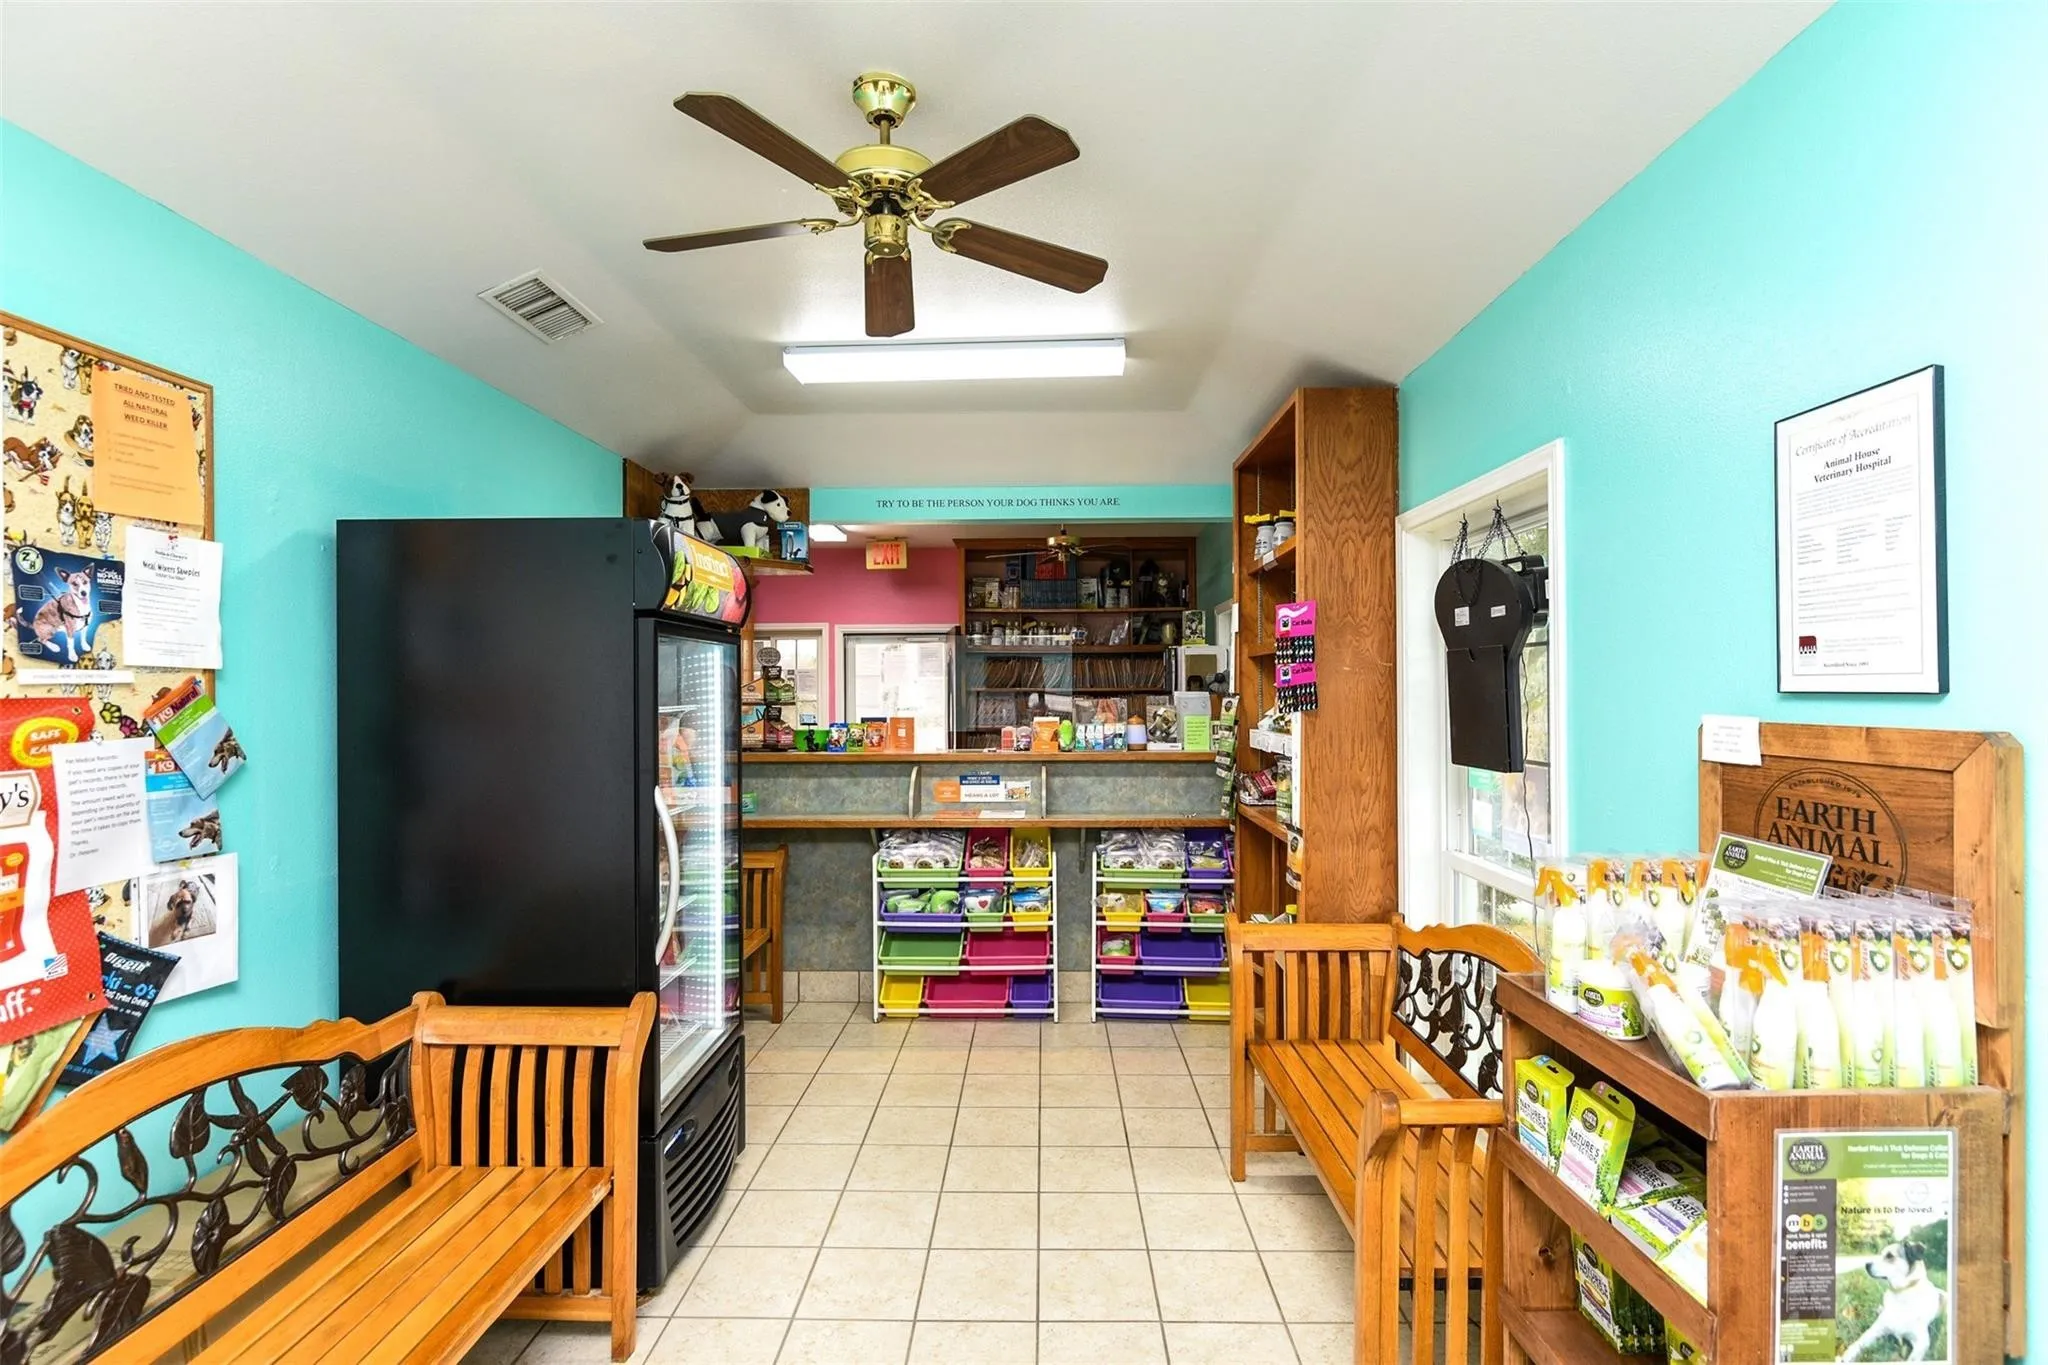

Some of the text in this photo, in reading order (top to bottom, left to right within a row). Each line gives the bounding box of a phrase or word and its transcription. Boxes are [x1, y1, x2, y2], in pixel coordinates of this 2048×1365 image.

[114, 383, 175, 407] TRIED AND TESTED
[123, 400, 168, 417] ALL NATURAL
[124, 413, 168, 429] WEED KILLER
[1795, 414, 1912, 457] Certificate of Accreditation
[1824, 448, 1881, 469] Animal House
[1814, 455, 1892, 484] Veterinary Hospital
[876, 499, 894, 508] TRY
[897, 499, 910, 508] TO
[912, 499, 923, 508] BE
[926, 499, 945, 507] THE
[947, 499, 984, 507] PERSON
[987, 499, 1014, 507] YOUR
[1016, 498, 1037, 507] DOG
[1040, 498, 1075, 507] THINKS
[1077, 498, 1098, 506] YOU
[873, 543, 900, 566] EXIT
[1788, 777, 1841, 790] ESTABLISHED
[1776, 795, 1877, 836] EARTH
[1728, 845, 1747, 854] EARTH
[1767, 820, 1893, 868] ANIMAL
[1725, 850, 1746, 861] ANIMAL
[1519, 1098, 1547, 1126] NATURE'S
[1519, 1105, 1547, 1132] PROTECTION
[1567, 1134, 1598, 1165] PROTECTION
[1569, 1127, 1600, 1158] NATURE'S
[1791, 1144, 1823, 1154] EARTH
[1847, 1145, 1869, 1153] Herbal
[1903, 1144, 1929, 1153] Defense
[1929, 1144, 1949, 1152] Collar
[1788, 1152, 1826, 1161] ANIMAL
[1901, 1152, 1911, 1160] for
[1911, 1152, 1928, 1161] Dogs
[1934, 1152, 1949, 1160] Cats
[1668, 1200, 1697, 1222] PROTEC
[1673, 1196, 1703, 1217] NATU
[1840, 1206, 1872, 1214] Nature
[1873, 1206, 1881, 1214] is
[1883, 1206, 1893, 1214] to
[1894, 1206, 1906, 1214] be
[1785, 1239, 1828, 1250] benefits
